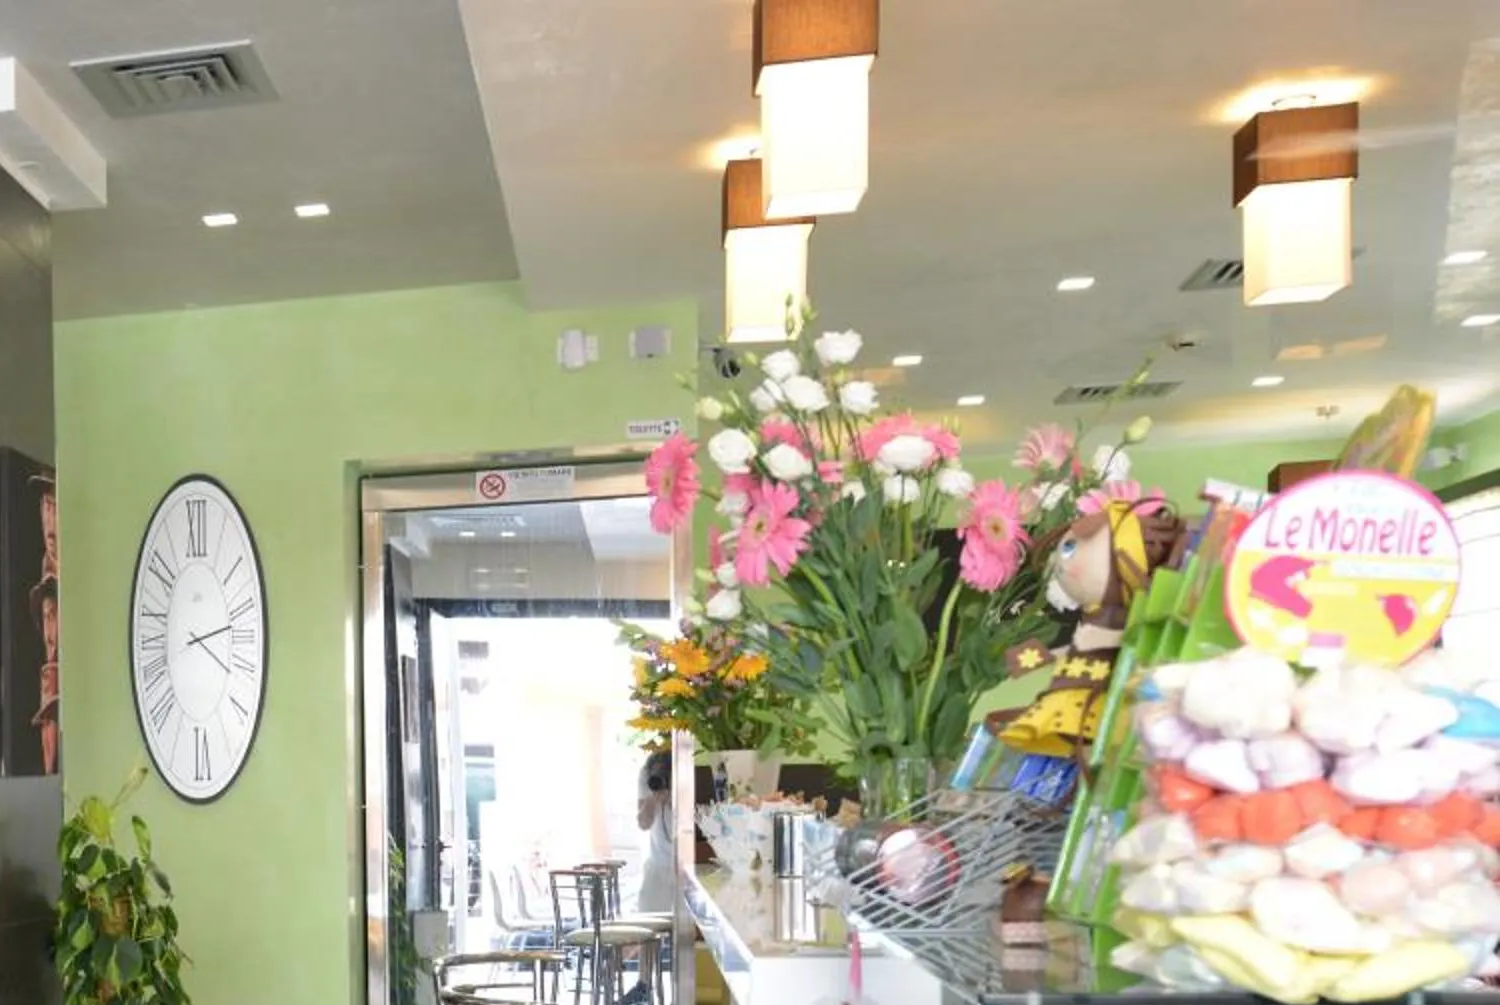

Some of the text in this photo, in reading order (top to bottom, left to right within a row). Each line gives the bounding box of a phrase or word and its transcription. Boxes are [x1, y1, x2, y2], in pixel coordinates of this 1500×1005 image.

[185, 499, 208, 558] XII
[1265, 506, 1437, 555] Le Monelle
